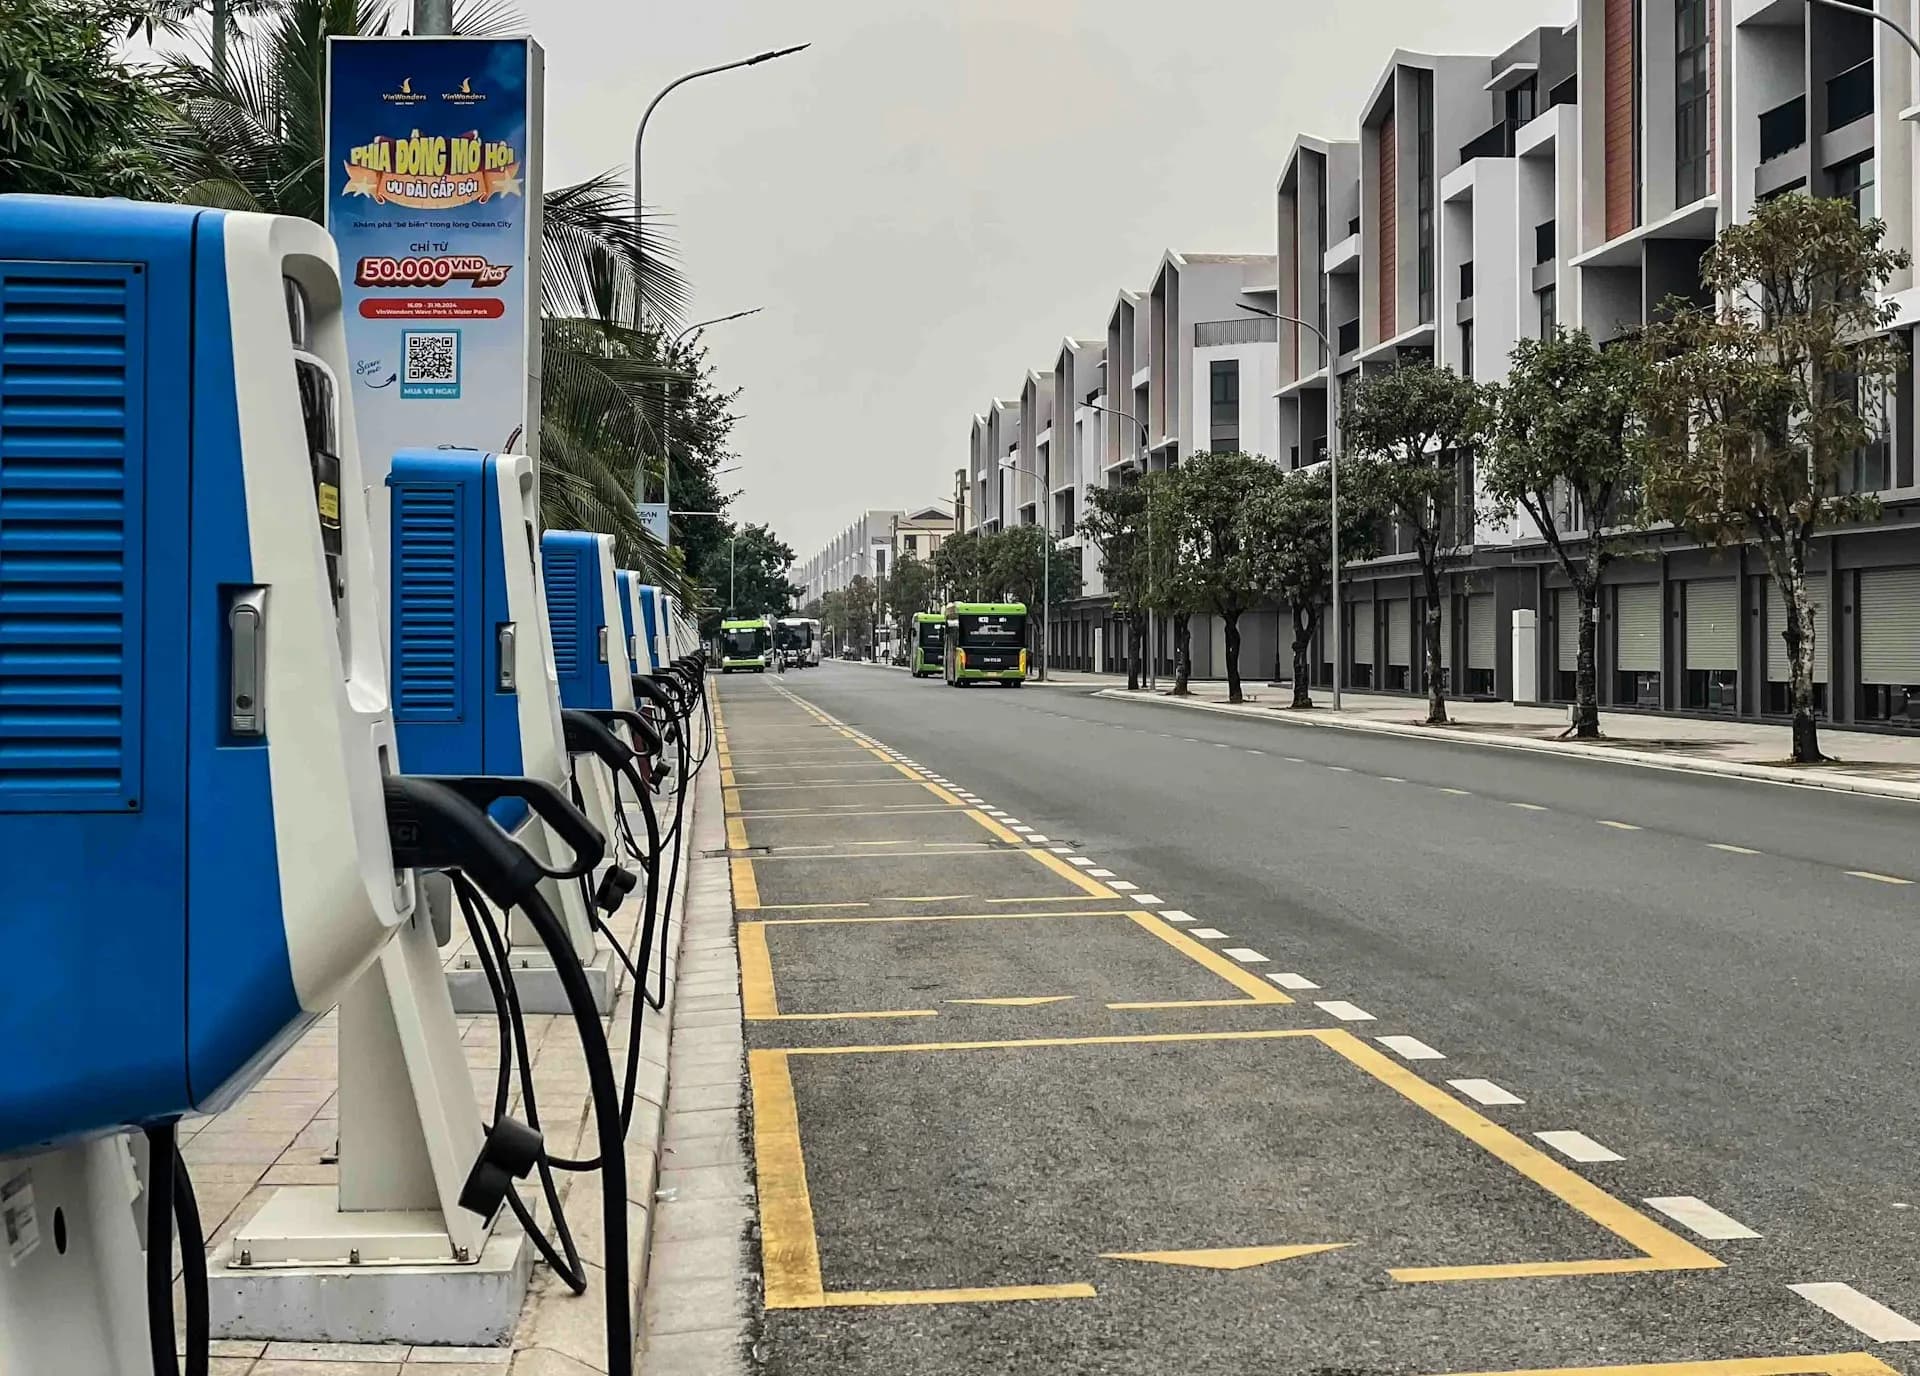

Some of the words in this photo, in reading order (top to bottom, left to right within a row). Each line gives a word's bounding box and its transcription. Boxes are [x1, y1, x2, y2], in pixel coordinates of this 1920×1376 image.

[382, 93, 426, 101] VinWonders
[441, 93, 486, 101] VinWonders
[351, 136, 391, 173] PHÍA
[395, 128, 447, 177] ĐÔNG
[450, 130, 481, 176] MỞ
[485, 141, 514, 172] HỘI
[387, 180, 403, 194] ƯU
[406, 179, 428, 198] ĐÃI
[430, 177, 454, 198] GẤP
[458, 179, 477, 195] BỘI
[430, 220, 451, 229] trong
[471, 220, 496, 228] Ocean
[497, 220, 513, 229] City
[410, 240, 429, 252] CHỈ
[432, 241, 449, 252] TỪ
[364, 260, 450, 278] 50.000
[451, 259, 484, 270] VND
